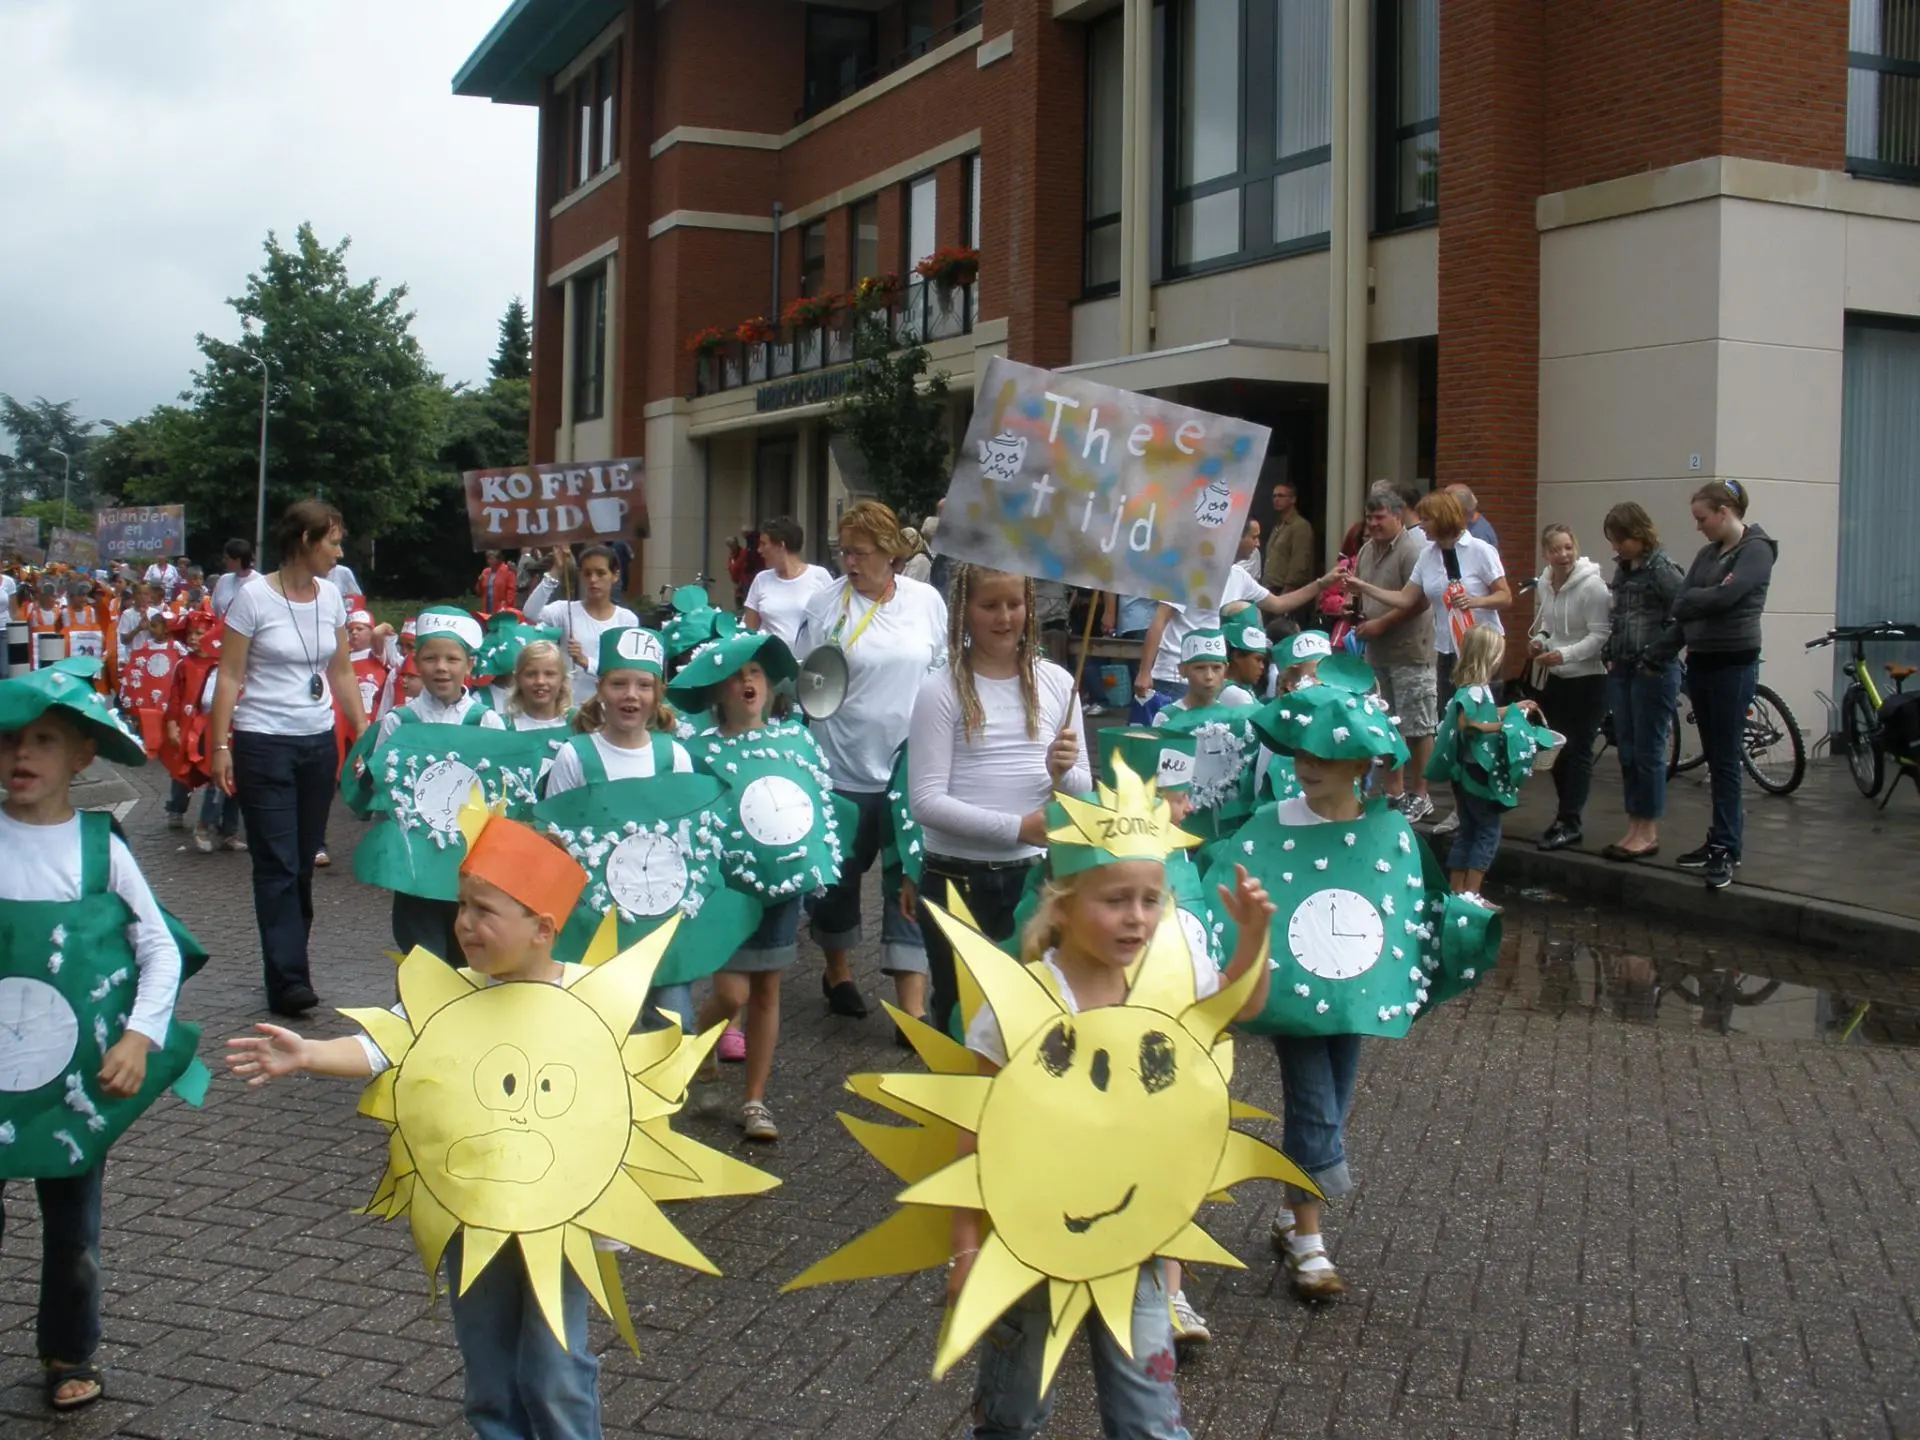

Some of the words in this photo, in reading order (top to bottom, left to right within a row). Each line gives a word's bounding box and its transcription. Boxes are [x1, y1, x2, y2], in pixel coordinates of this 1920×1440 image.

[1045, 391, 1206, 464] Thee
[1692, 455, 1698, 467] 2
[480, 463, 634, 503] KOFFIE
[98, 510, 169, 527] kalender
[482, 504, 584, 534] TIJD
[1031, 473, 1156, 553] tijd
[124, 524, 143, 536] en
[107, 537, 163, 555] agenda
